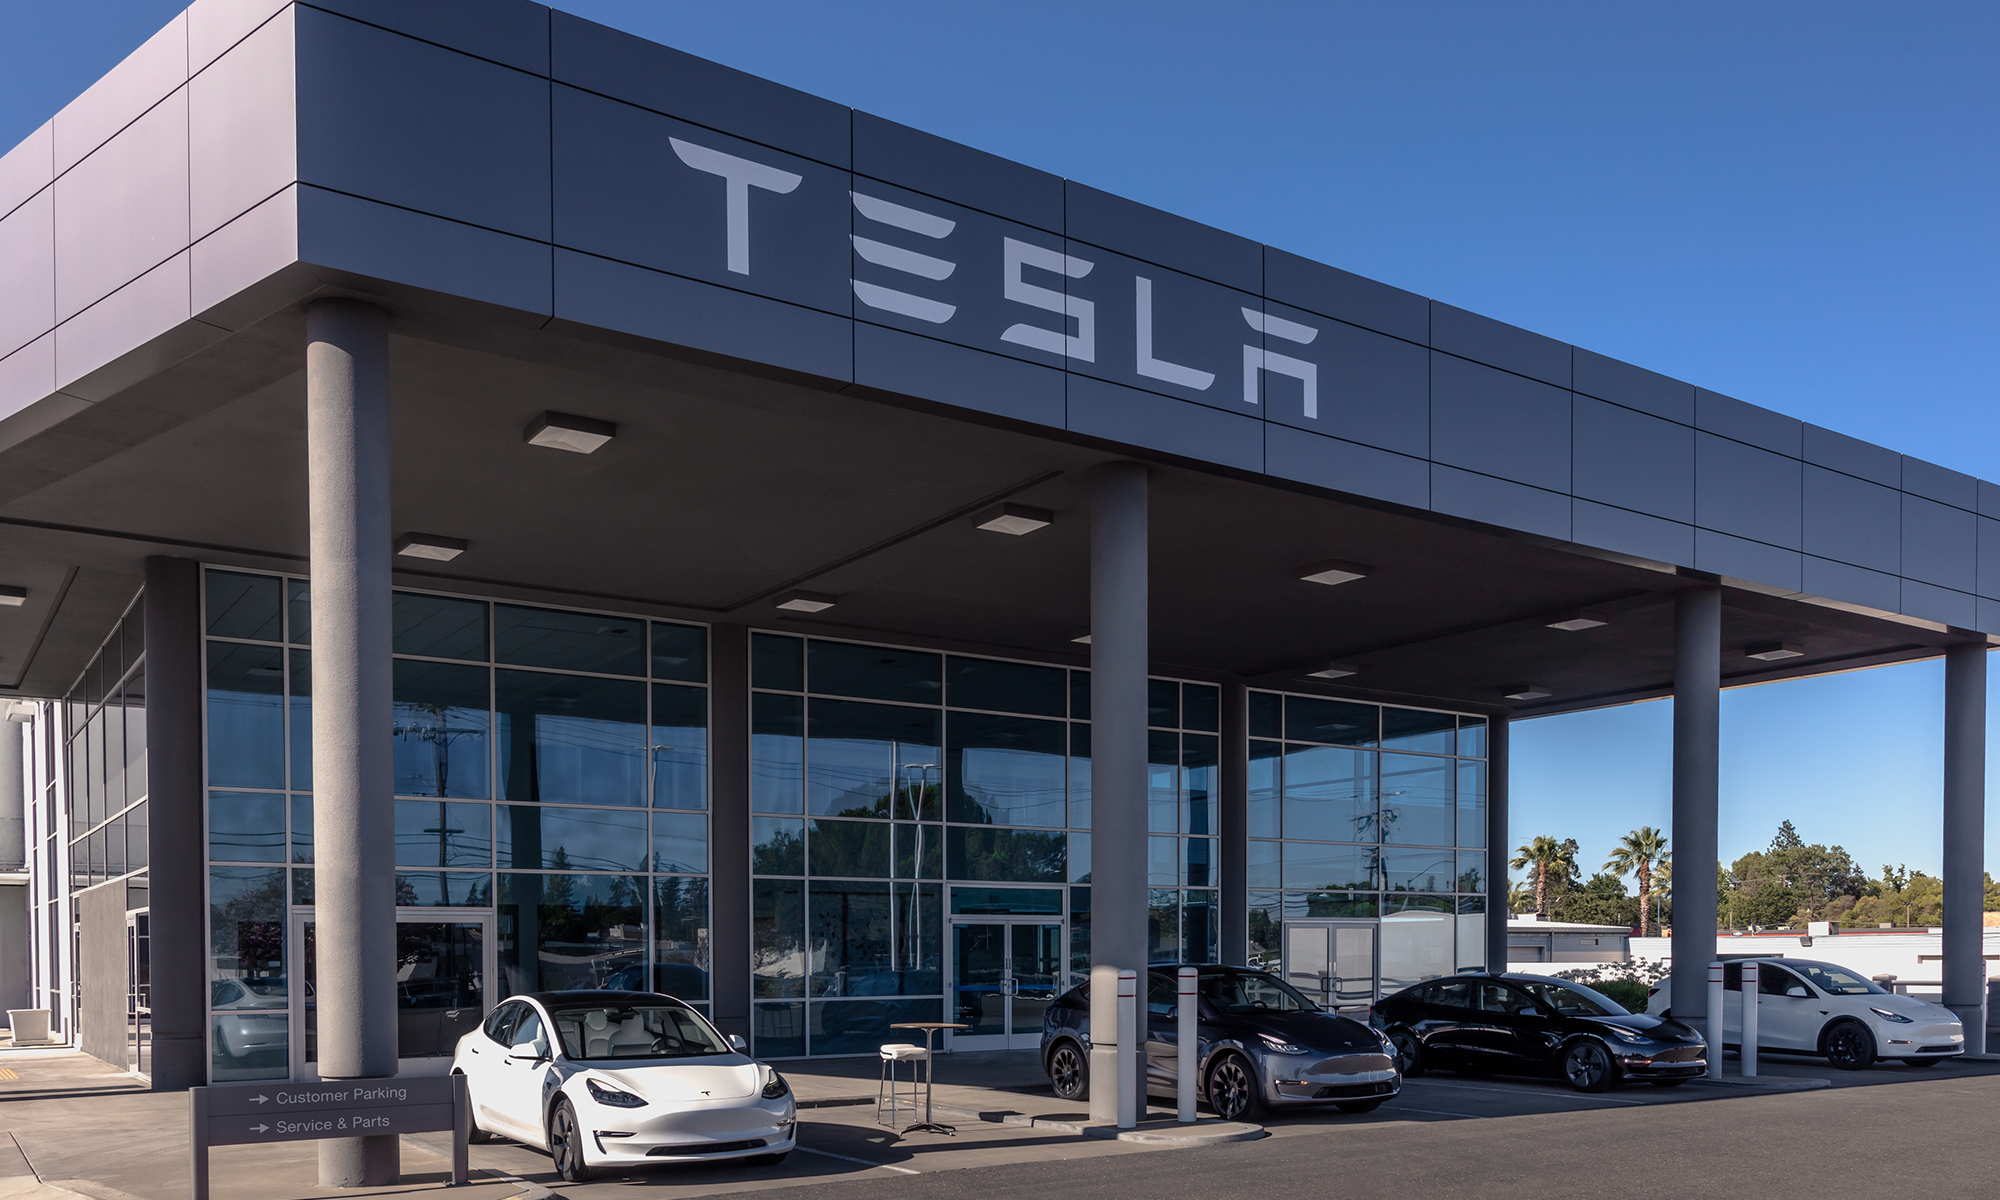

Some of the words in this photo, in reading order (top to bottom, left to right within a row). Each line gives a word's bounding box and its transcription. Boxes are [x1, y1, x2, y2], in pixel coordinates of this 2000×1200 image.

[669, 137, 1318, 419] TESLA
[276, 1090, 349, 1105] Customer
[353, 1086, 407, 1101] Parking
[276, 1118, 333, 1134] Service
[337, 1117, 348, 1130] &
[352, 1116, 390, 1129] Parts
